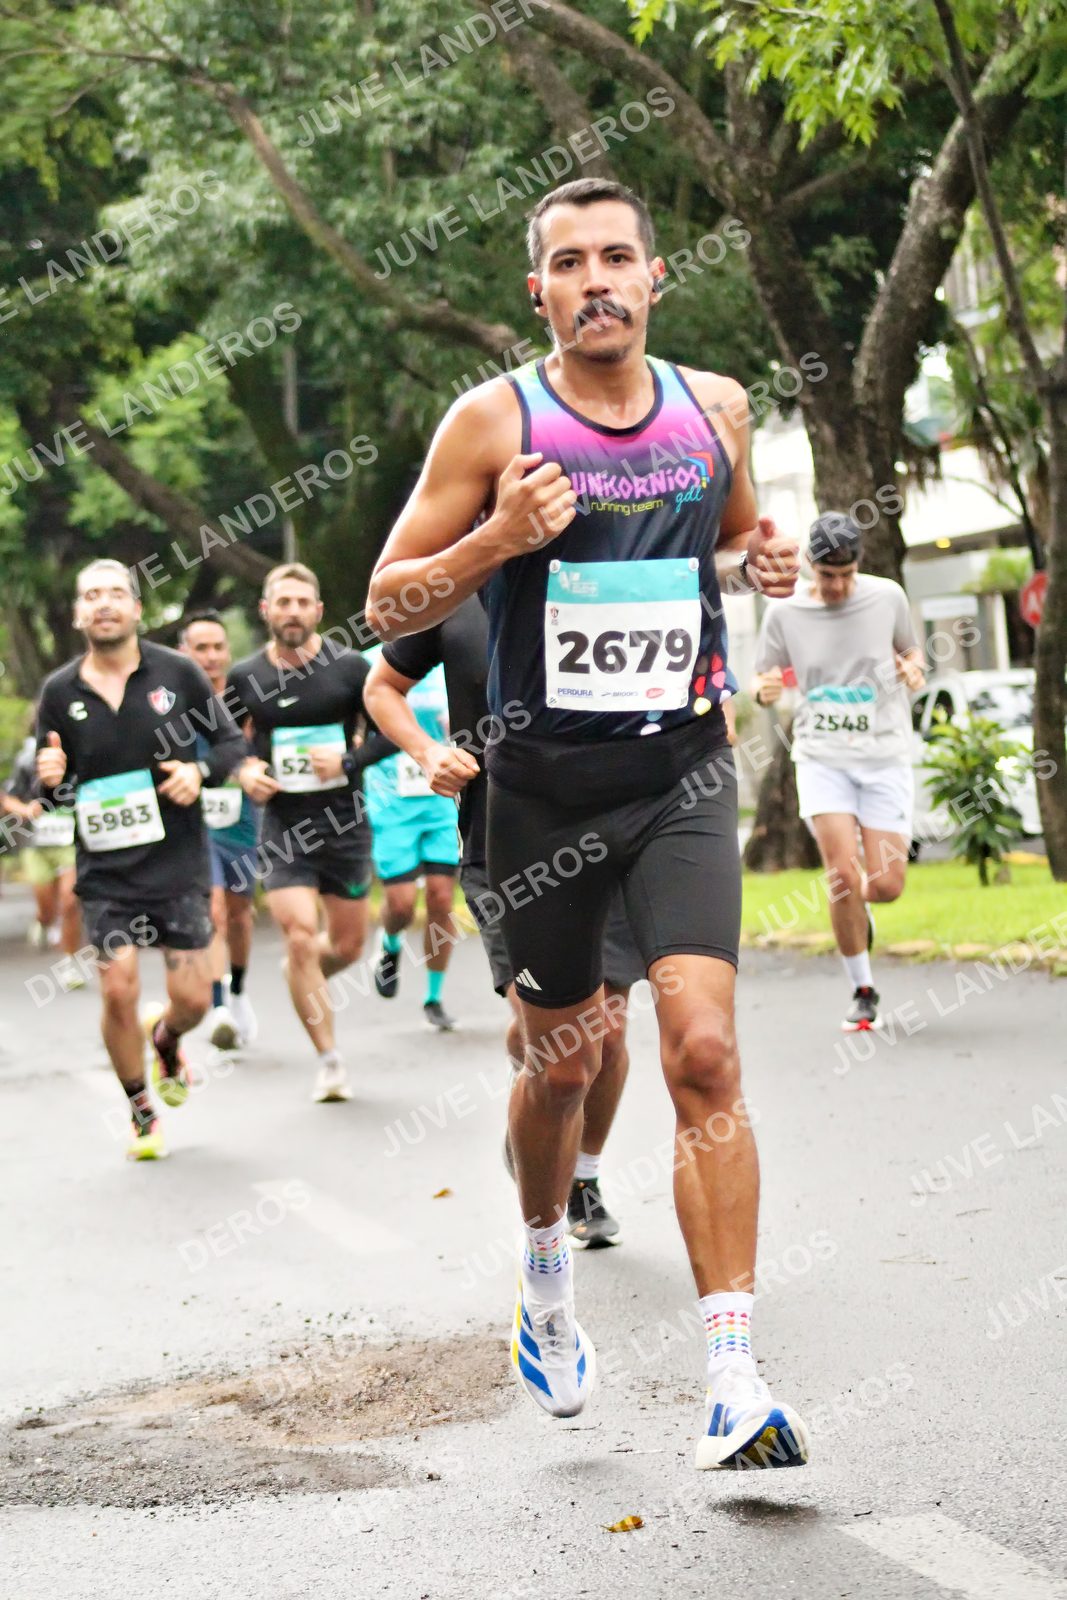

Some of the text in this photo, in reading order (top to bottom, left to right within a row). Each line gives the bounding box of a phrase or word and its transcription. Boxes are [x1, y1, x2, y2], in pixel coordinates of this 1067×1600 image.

[591, 499, 664, 517] running team
[556, 628, 693, 675] 2679
[557, 687, 594, 697] PERDURA
[814, 713, 869, 732] 2548
[86, 804, 153, 835] 5983
